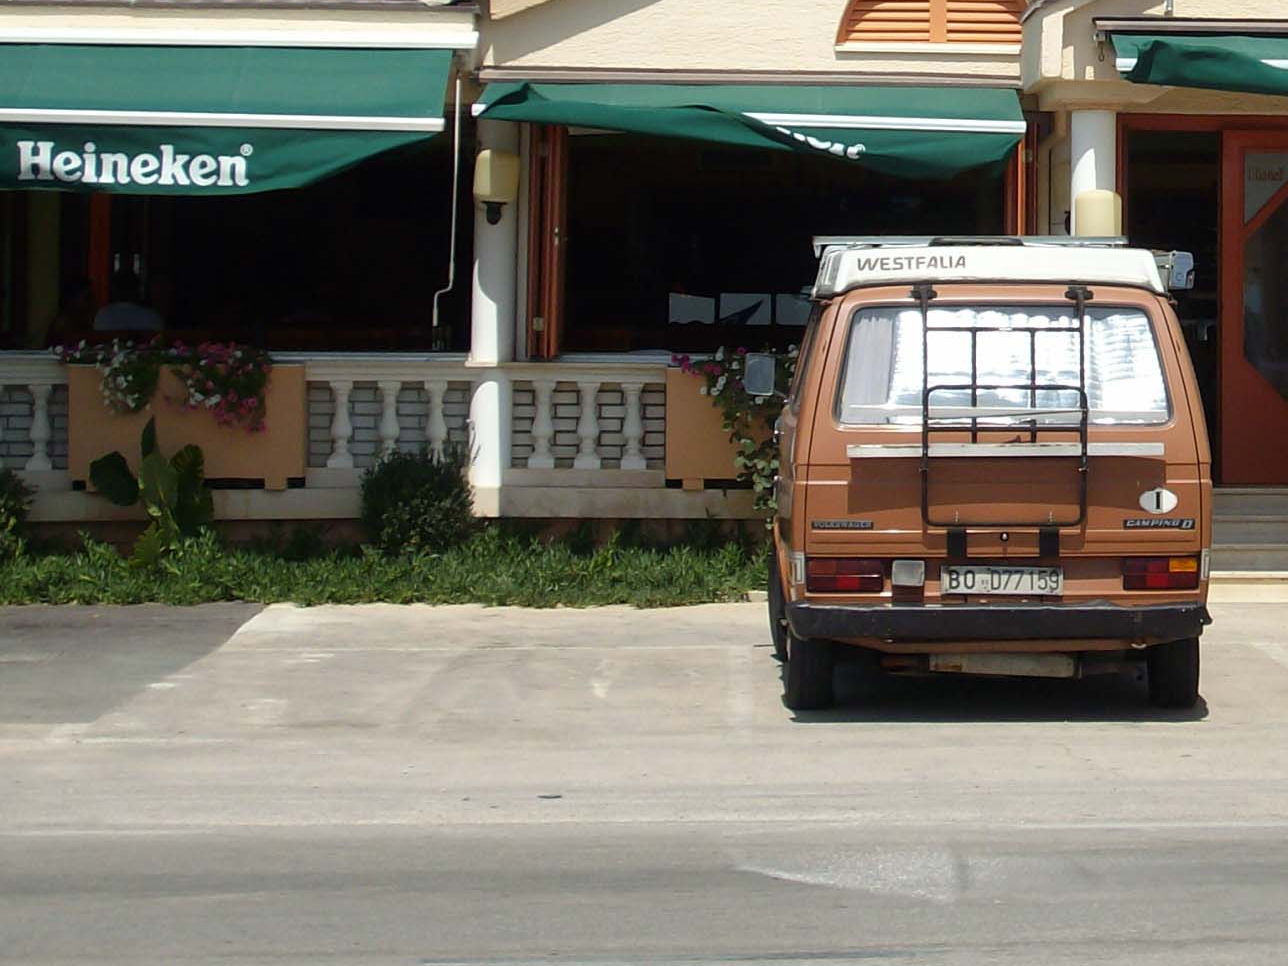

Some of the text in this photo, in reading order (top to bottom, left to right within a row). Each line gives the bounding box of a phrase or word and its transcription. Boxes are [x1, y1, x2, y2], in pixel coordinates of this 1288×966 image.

[857, 255, 967, 271] WESTFALIA
[948, 569, 1060, 591] BO D77159
